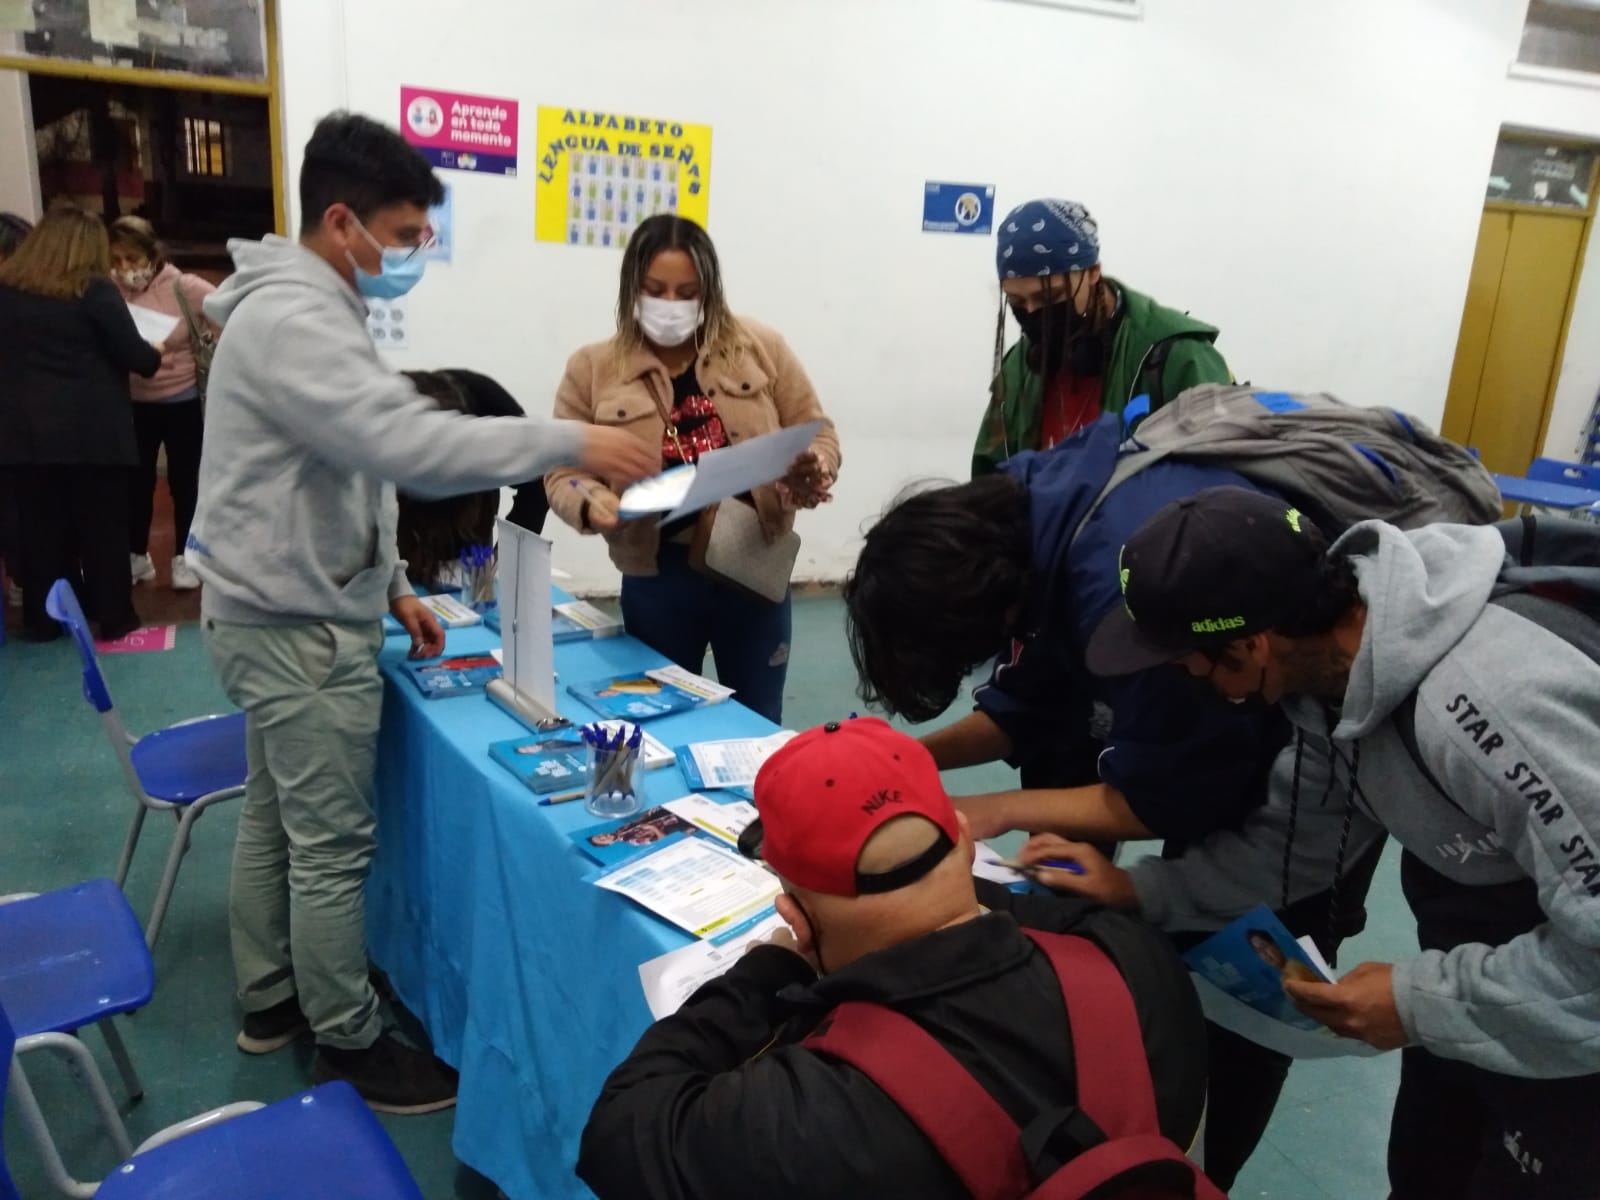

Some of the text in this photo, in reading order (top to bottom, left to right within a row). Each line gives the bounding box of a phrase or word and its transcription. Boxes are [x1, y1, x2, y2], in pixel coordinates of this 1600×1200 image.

[451, 100, 507, 121] Aprende
[451, 116, 501, 133] en todo
[563, 109, 683, 137] ALFABETO
[451, 129, 511, 148] momento
[539, 135, 702, 195] LENGUA DE SEÑAS
[1191, 616, 1246, 632] adidas
[1446, 694, 1504, 757] STAR
[1504, 762, 1564, 826] STAR
[861, 788, 904, 817] NIKE
